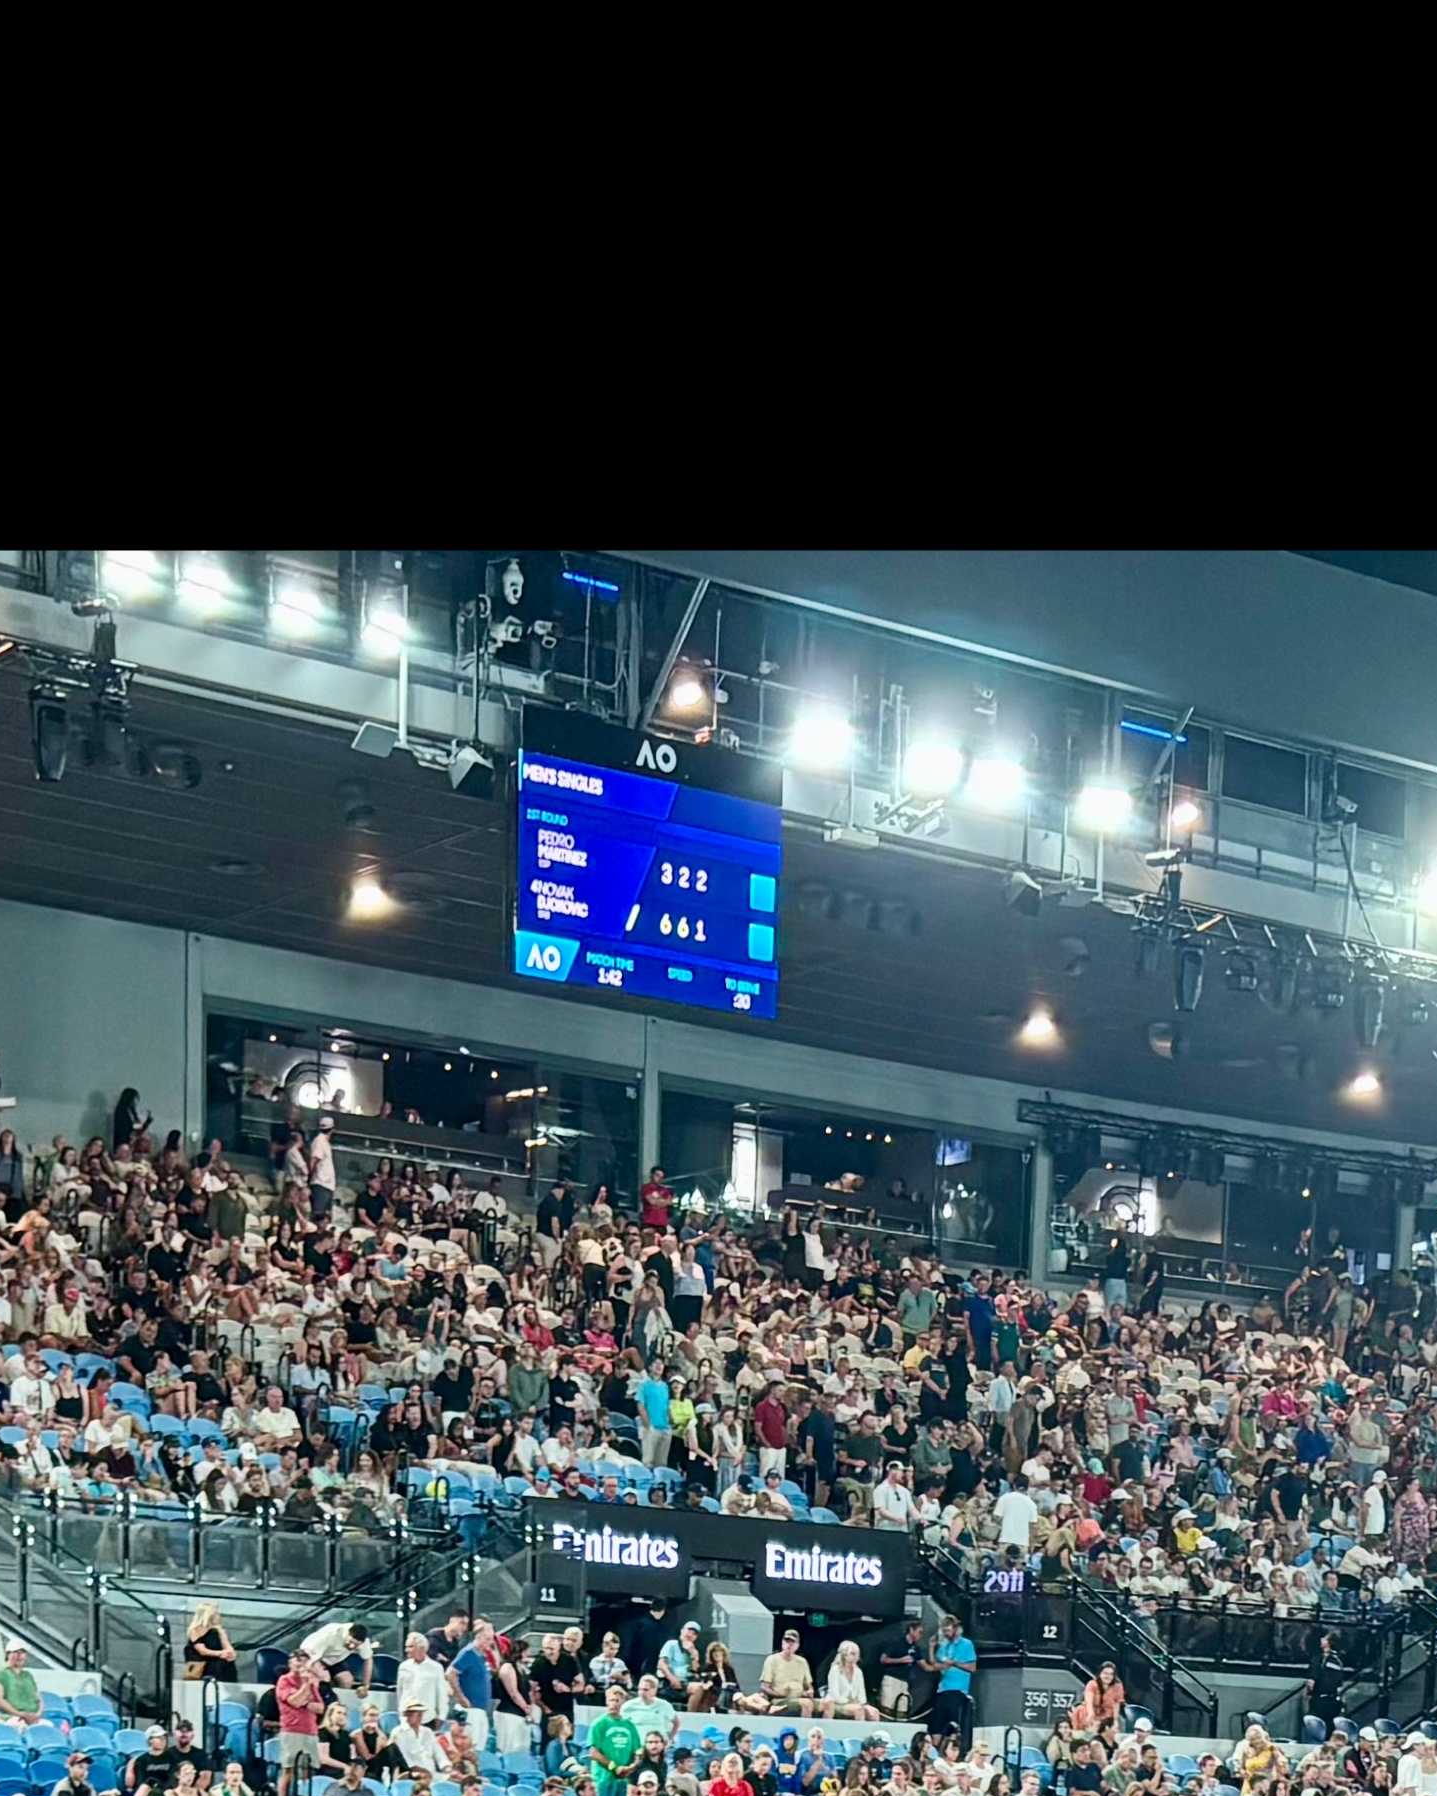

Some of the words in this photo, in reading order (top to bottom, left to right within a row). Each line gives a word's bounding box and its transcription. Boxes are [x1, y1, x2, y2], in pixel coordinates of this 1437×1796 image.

[636, 739, 677, 773] AO
[557, 770, 604, 796] SINGLES
[538, 828, 575, 850] PEDRO
[661, 862, 673, 885] 3
[678, 866, 690, 889] 2
[696, 869, 707, 892] 2
[659, 913, 673, 935] 6
[677, 916, 690, 938] 6
[694, 919, 706, 942] 1
[526, 943, 561, 972] AO
[765, 1540, 883, 1587] Emirates
[540, 1587, 557, 1603] 11
[1042, 1625, 1058, 1639] 12
[1024, 1691, 1049, 1707] 356
[1052, 1692, 1075, 1707] 357
